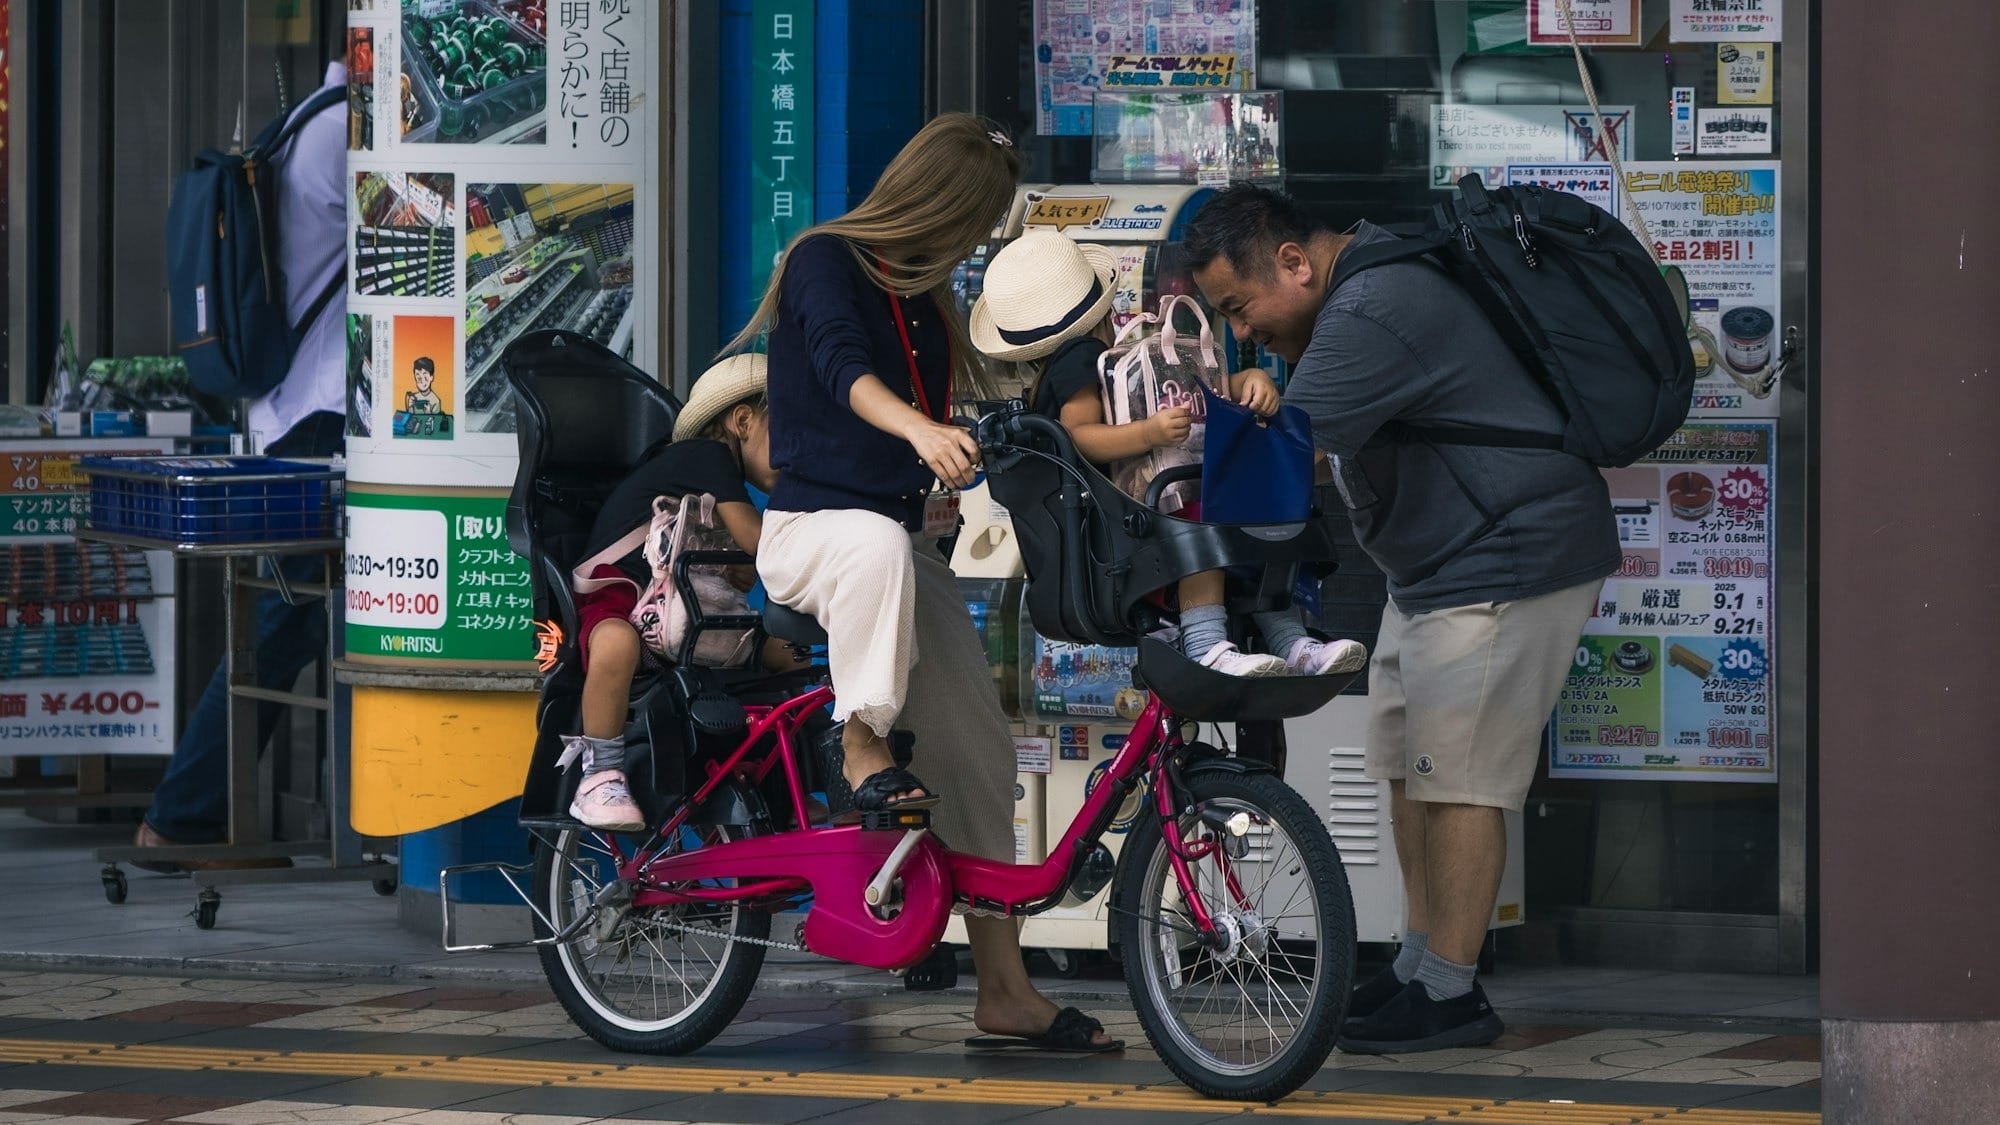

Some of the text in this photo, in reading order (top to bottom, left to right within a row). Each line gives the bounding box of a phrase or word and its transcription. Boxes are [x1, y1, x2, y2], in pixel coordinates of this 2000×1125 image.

[560, 1, 590, 149] 明らかに！
[771, 13, 795, 218] 日本橋五丁目
[1438, 109, 1475, 122] 当店に
[1438, 124, 1558, 138] トイレはございません。
[1438, 140, 1463, 151] There
[1465, 141, 1473, 150] is
[1489, 141, 1505, 150] rest
[1626, 169, 1750, 193] ビニル電線祭り
[1031, 203, 1102, 218] 人気です！
[1123, 218, 1162, 229] STATION
[1648, 448, 1759, 463] anniversary
[12, 476, 39, 490] 40
[1716, 507, 1765, 518] スピーカー
[455, 514, 508, 540] 【取り
[1698, 519, 1765, 532] ネットワーク用
[1667, 531, 1766, 544] 空芯コイル 0.68mH
[457, 570, 531, 586] メカトロニク
[1714, 583, 1737, 592] 2025
[1640, 588, 1681, 609] 厳選
[1713, 592, 1745, 610] 9.1
[1617, 612, 1711, 627] 海外輸入品フェア
[1713, 617, 1756, 635] 9.21
[380, 634, 444, 653] KYOHRITSU
[1575, 646, 1602, 668] 0%
[1748, 668, 1764, 676] OFF
[1565, 675, 1642, 688] ロイダルトランス
[1701, 679, 1766, 690] メタルクラッド
[1593, 690, 1609, 701] 2A
[1703, 690, 1767, 703] 抵抗(Jランク)
[1603, 704, 1618, 715] 2A
[1724, 705, 1747, 715] 50W
[1016, 743, 1044, 752] aution!!
